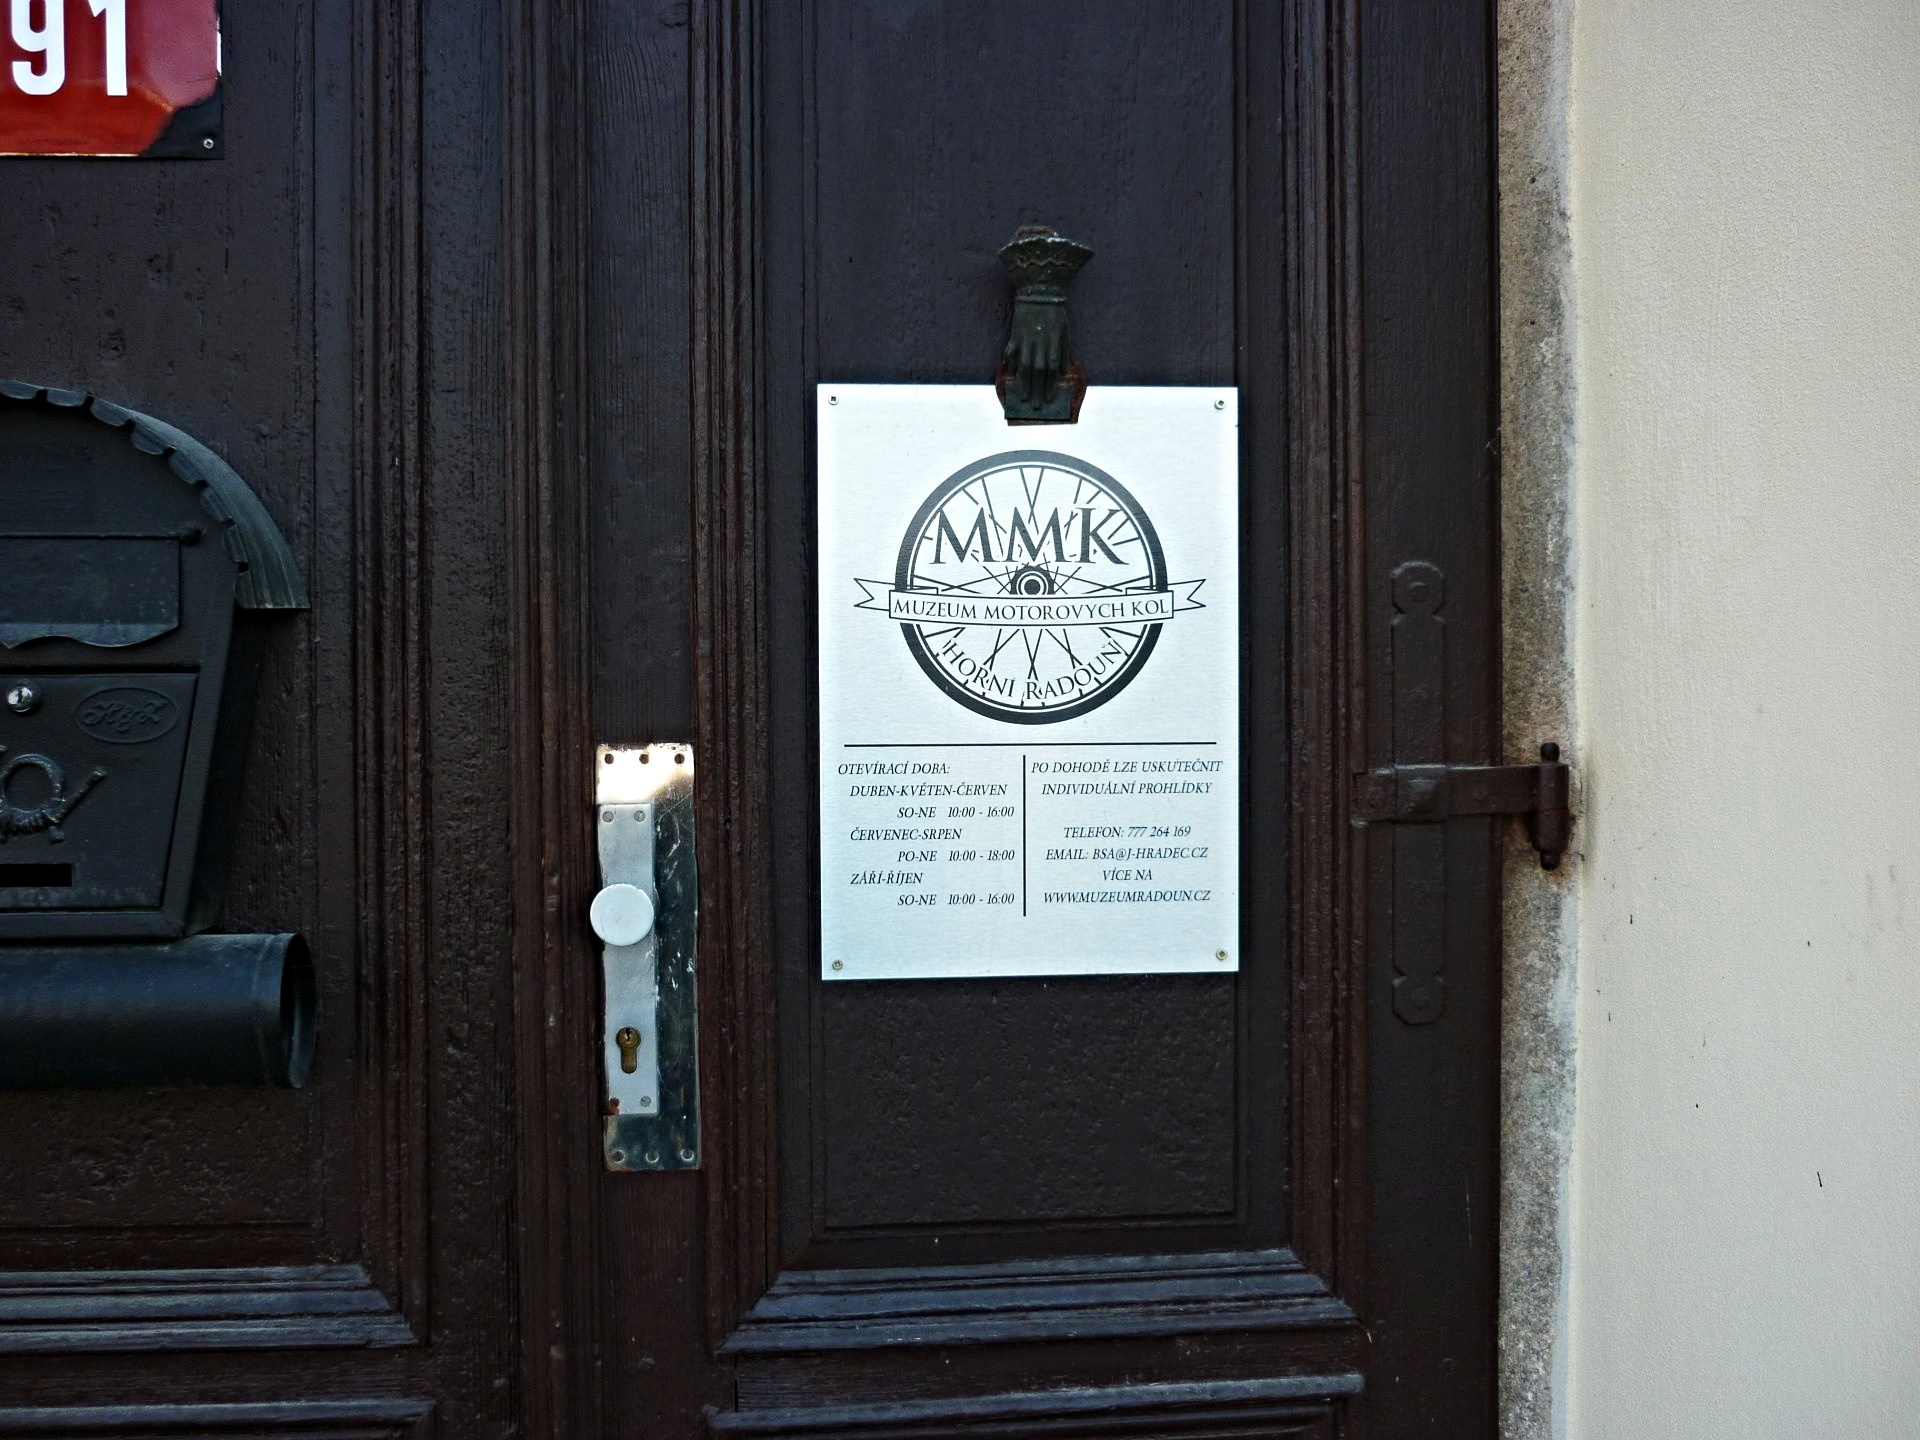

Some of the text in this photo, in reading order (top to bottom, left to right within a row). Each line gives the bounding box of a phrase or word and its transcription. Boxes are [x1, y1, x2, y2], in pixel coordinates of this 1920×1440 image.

[11, 0, 128, 96] 91
[929, 506, 1130, 565] MMK
[894, 599, 977, 619] MUZEUM
[1131, 598, 1169, 617] KOL
[838, 761, 950, 775] OTEVÍRACÍ DOBA:
[1031, 758, 1223, 773] PO DOHODĚ LZE USKUTEČNIT
[850, 782, 1008, 797] DUBEN-KVĚTEN-ČERVEN
[1041, 781, 1212, 795] INDIVIDUÁLNÍ PROHLÍDKY
[897, 807, 936, 818] SO-NE
[948, 807, 975, 817] 10:00
[987, 806, 1015, 817] 16:00
[850, 827, 963, 841] ČERVENEC-SRPEN
[1064, 826, 1191, 838] TELEFON: 777 264 169
[897, 851, 937, 862] PO-NE
[948, 851, 976, 861] 10:00
[987, 850, 1015, 861] 18:00
[1045, 847, 1209, 861] EMAIL: BSA@J-HRADEC.CZ
[850, 870, 923, 886] ZÁŘÍ-ŘÍJEN
[1102, 867, 1153, 881] VÍCE NA
[897, 894, 937, 906] SO-NE
[948, 894, 976, 905] 10:00
[987, 894, 1015, 904] 16:00
[1044, 890, 1211, 903] WWW.MUZEUMRADOUN.CZ
